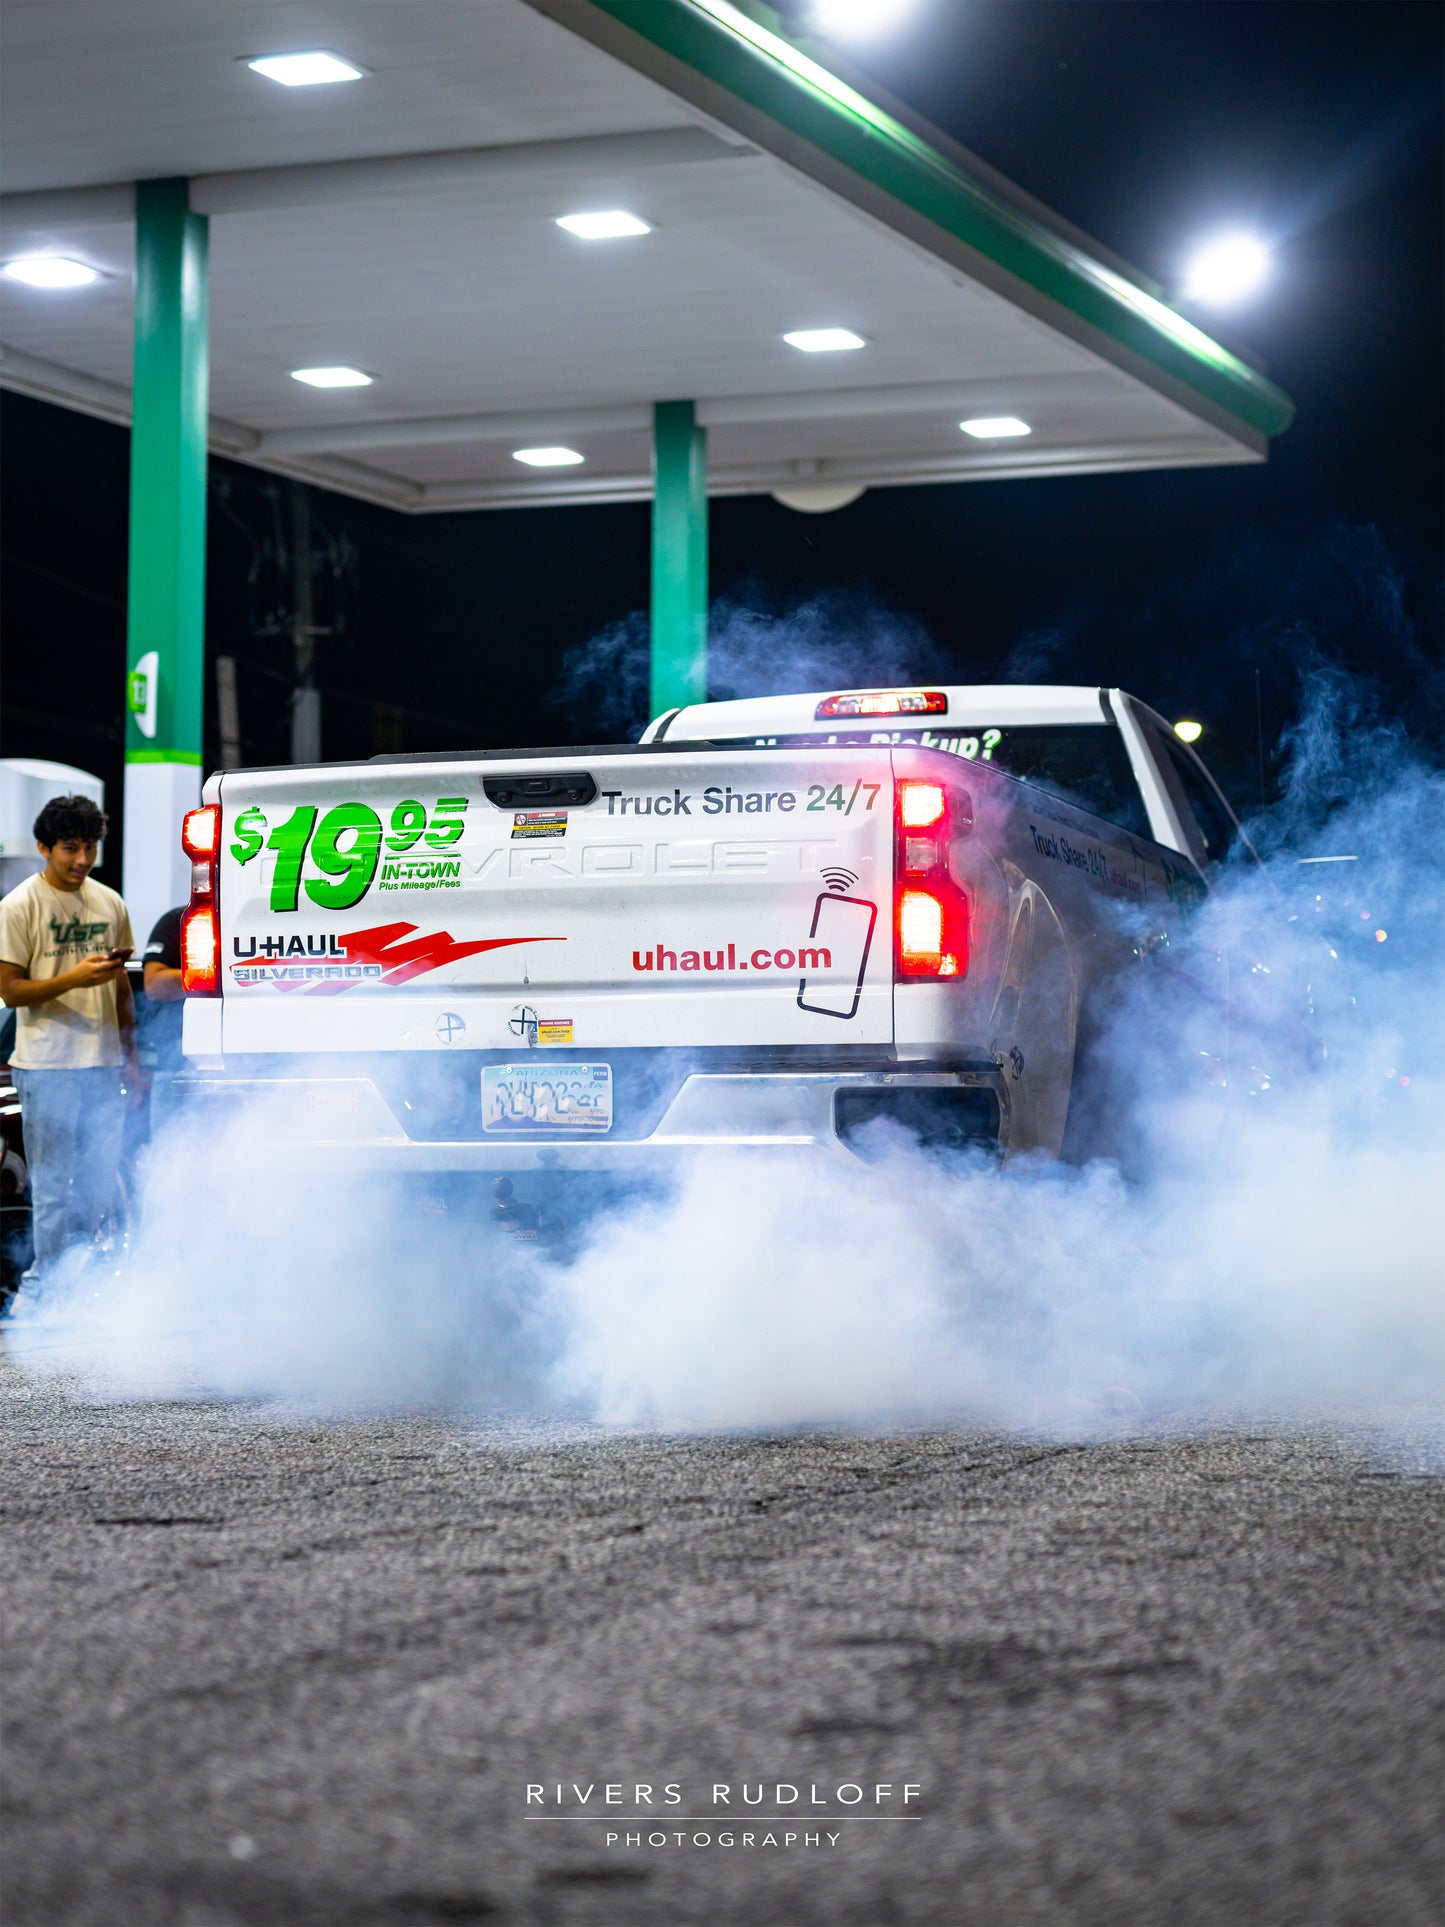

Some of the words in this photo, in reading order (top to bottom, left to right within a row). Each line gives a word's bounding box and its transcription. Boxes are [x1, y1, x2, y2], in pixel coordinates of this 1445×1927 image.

[602, 789, 692, 815] Truck
[702, 787, 797, 815] Share
[806, 778, 882, 816] 24/7
[1029, 824, 1062, 862] Truck
[1060, 838, 1091, 873] Share
[381, 862, 461, 880] IN-TOWN
[379, 881, 399, 890] Plus
[400, 880, 461, 890] Mileage/Fees
[233, 934, 345, 958] U-HAUL
[632, 943, 832, 971] uhaul.com
[233, 966, 381, 980] SILVERADO
[515, 1069, 579, 1077] ARIZONA
